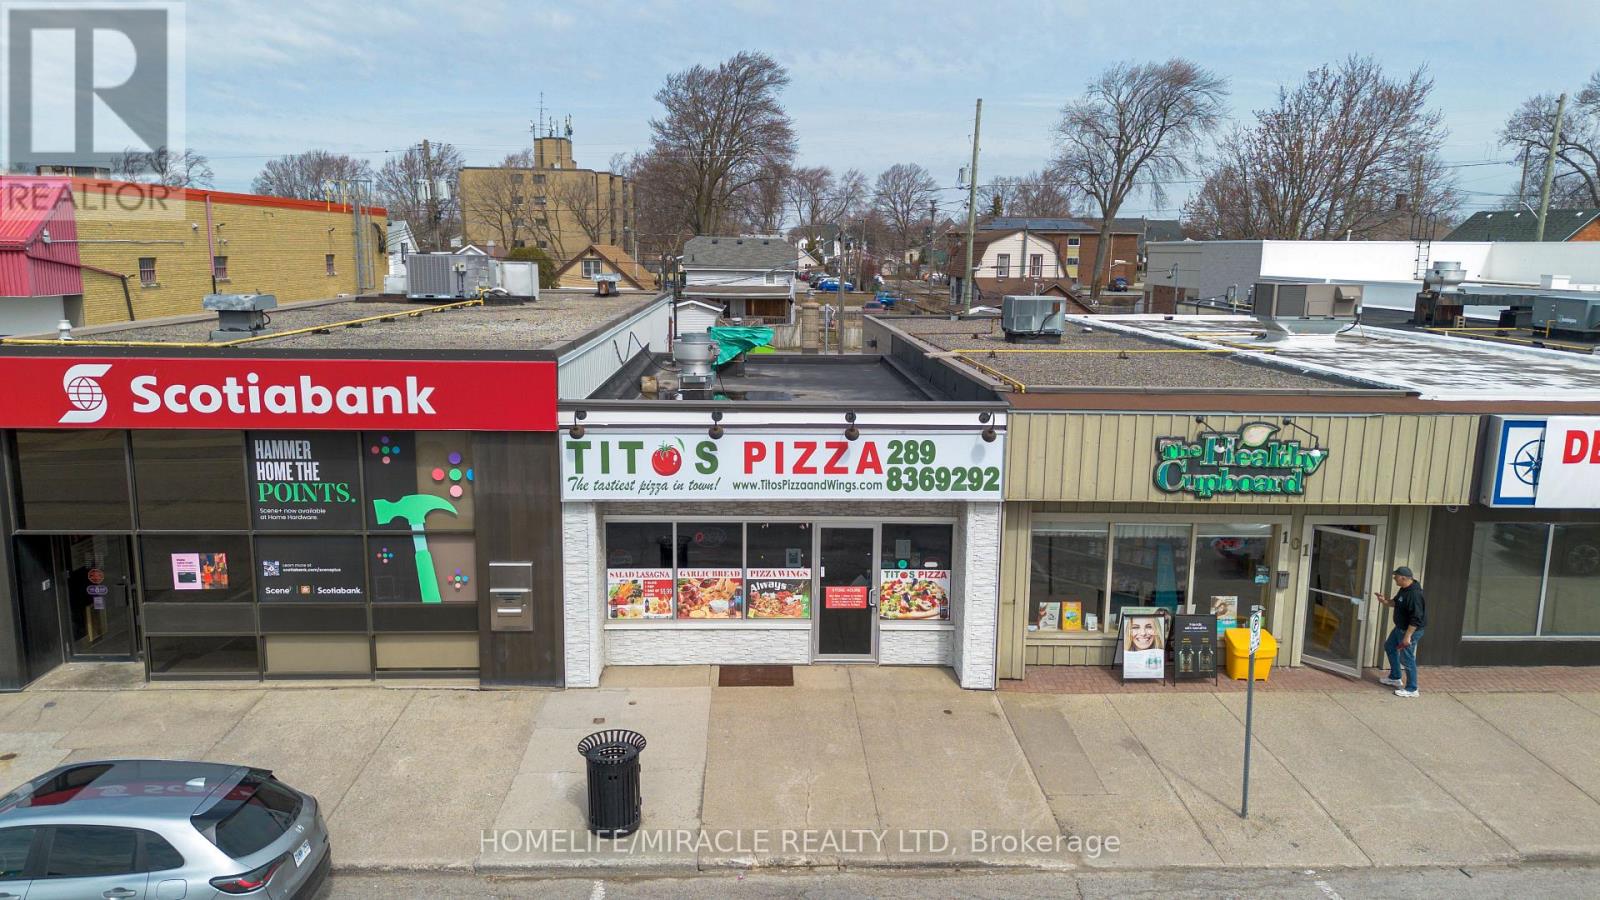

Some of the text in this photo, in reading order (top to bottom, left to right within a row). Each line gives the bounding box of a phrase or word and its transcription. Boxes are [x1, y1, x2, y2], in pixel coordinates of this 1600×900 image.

[130, 373, 437, 414] Scotiabank
[254, 440, 312, 460] HAMMER
[743, 441, 884, 475] PIZZA
[887, 439, 936, 465] 289
[1159, 433, 1329, 473] The Healthy
[256, 461, 320, 481] HOME THE
[886, 466, 1000, 492] 8369292
[1156, 460, 1304, 498] Cupboard
[257, 482, 356, 503] POINTS.
[567, 477, 721, 495] The tastiest pizza in town!
[732, 479, 883, 493] www.TitosPizzaandWings.com
[636, 571, 670, 579] LASAGNA
[750, 570, 808, 578] PIZZA WINGS
[918, 570, 947, 579] PIZZA
[751, 581, 788, 592] Always
